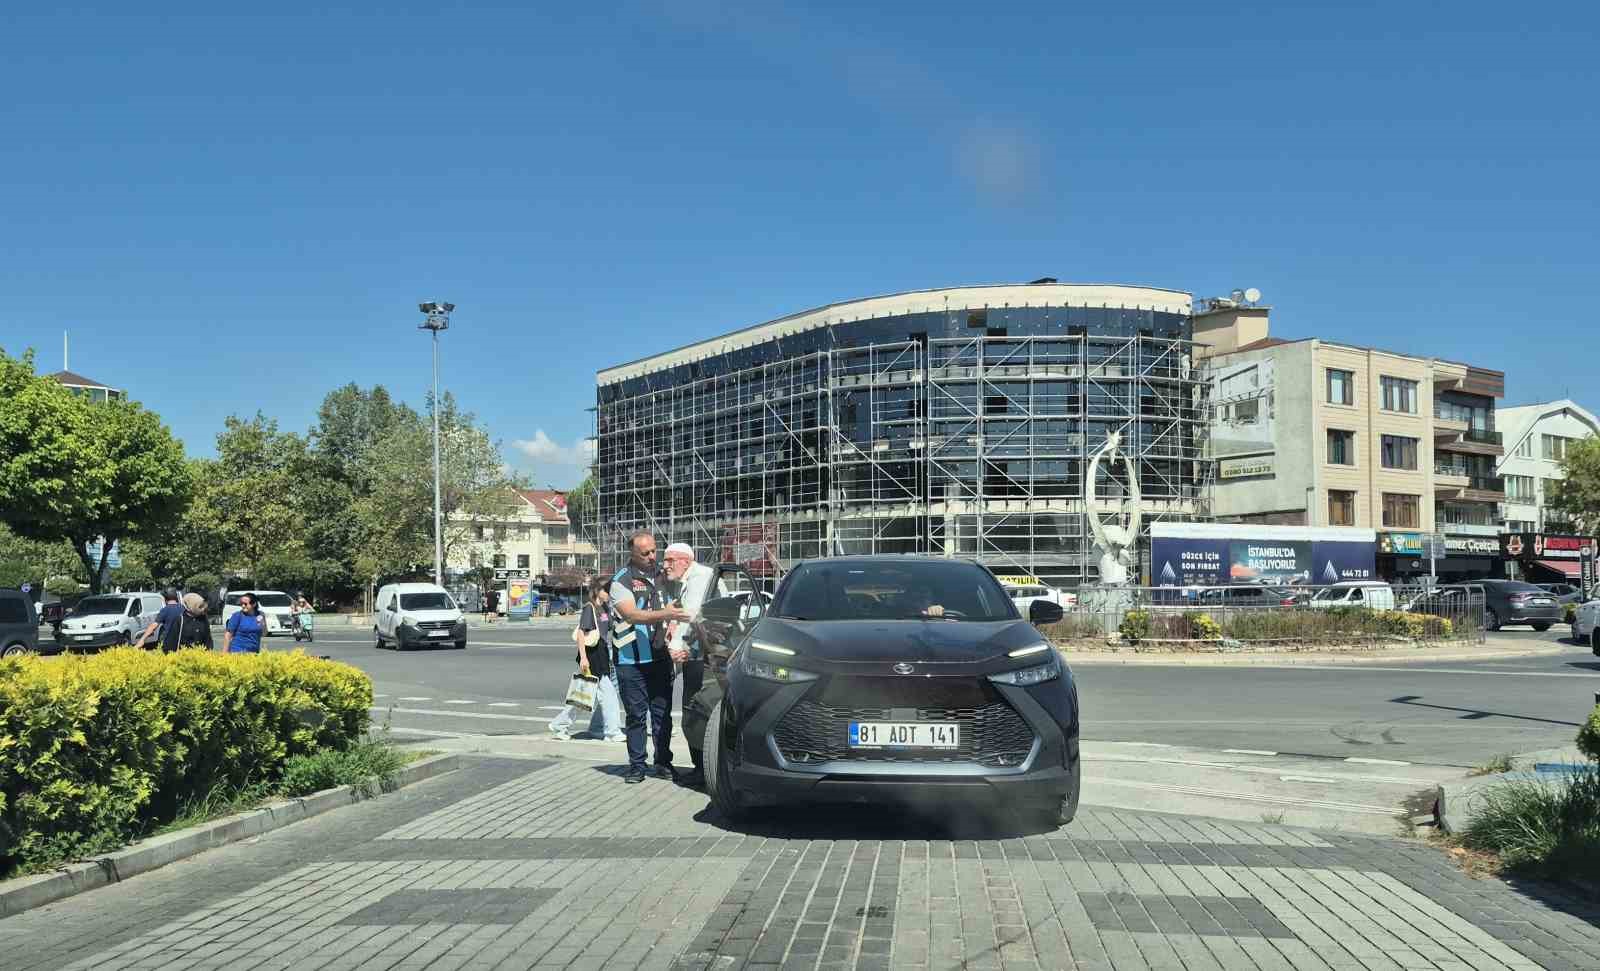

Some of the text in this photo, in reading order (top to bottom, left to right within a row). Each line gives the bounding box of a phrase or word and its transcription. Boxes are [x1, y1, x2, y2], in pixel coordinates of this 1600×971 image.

[1181, 551, 1203, 560] DÜZCE
[1247, 544, 1296, 558] İSTANBUL'DA
[1181, 562, 1196, 570] SON
[1248, 559, 1296, 572] BAŞLIYORUZ
[860, 725, 955, 743] 81 ADT 141
